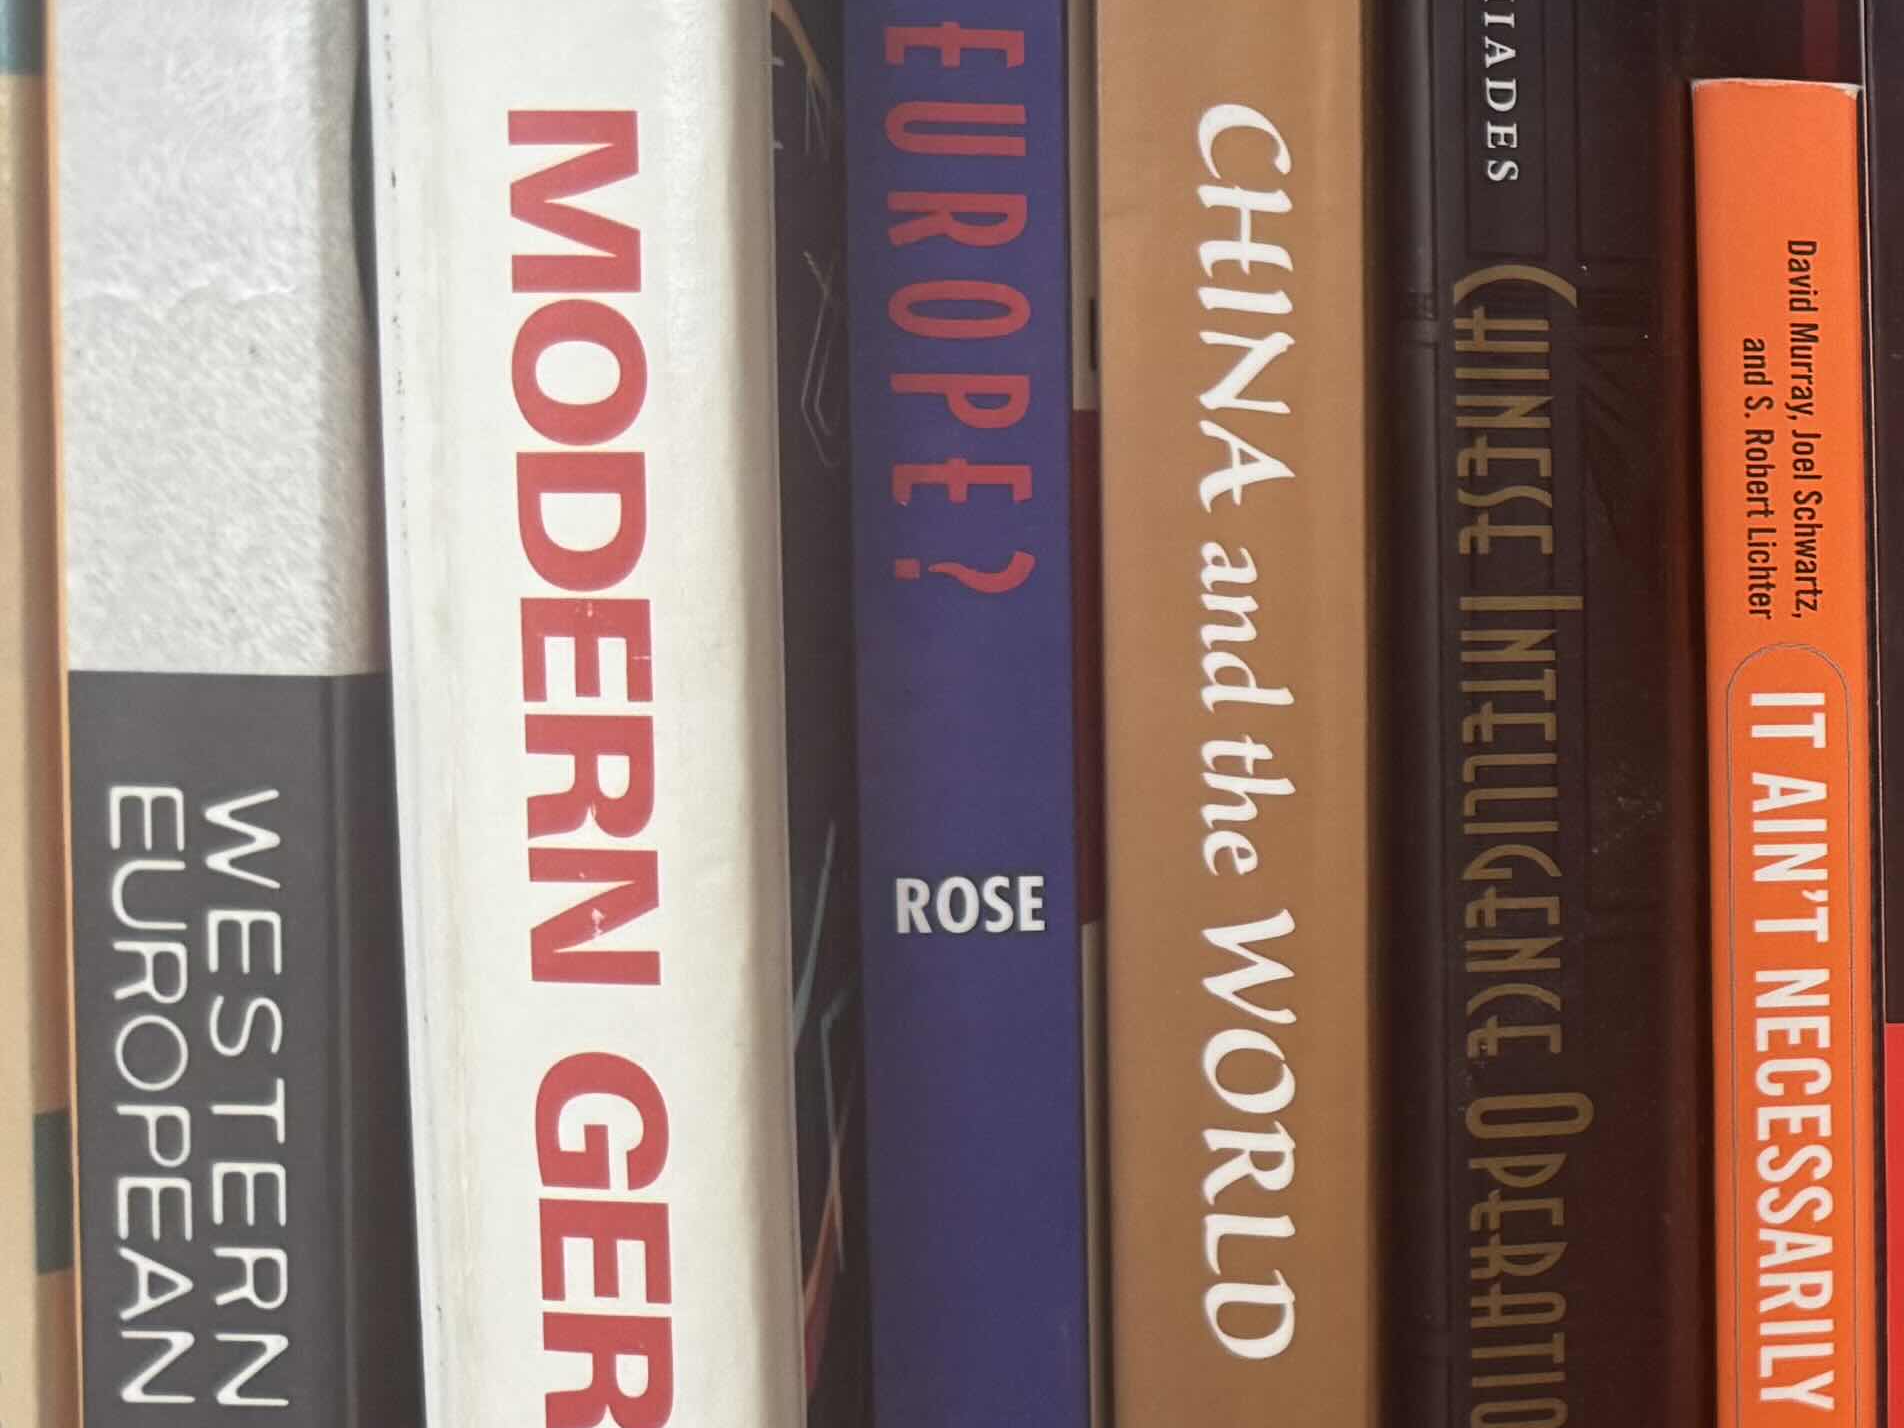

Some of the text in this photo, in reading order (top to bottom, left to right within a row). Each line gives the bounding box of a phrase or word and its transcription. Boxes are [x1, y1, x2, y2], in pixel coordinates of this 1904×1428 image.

[507, 109, 662, 986] MODERN
[1453, 263, 1578, 555] CHINESE
[1742, 337, 1778, 621] and S. Robert Lichter
[1784, 238, 1824, 620] David Murray, Joel Schwartz,
[894, 875, 1048, 935] ROSE
[1197, 102, 1298, 1360] CHINA and the WORLD
[1459, 594, 1585, 1061] INTELLIGENCE
[1749, 690, 1827, 749] IT
[1750, 772, 1829, 943] AIN'T
[108, 784, 196, 1405] EUROPEAN
[204, 788, 290, 1408] WESTERN
[1752, 969, 1837, 1411] NECESSARILY
